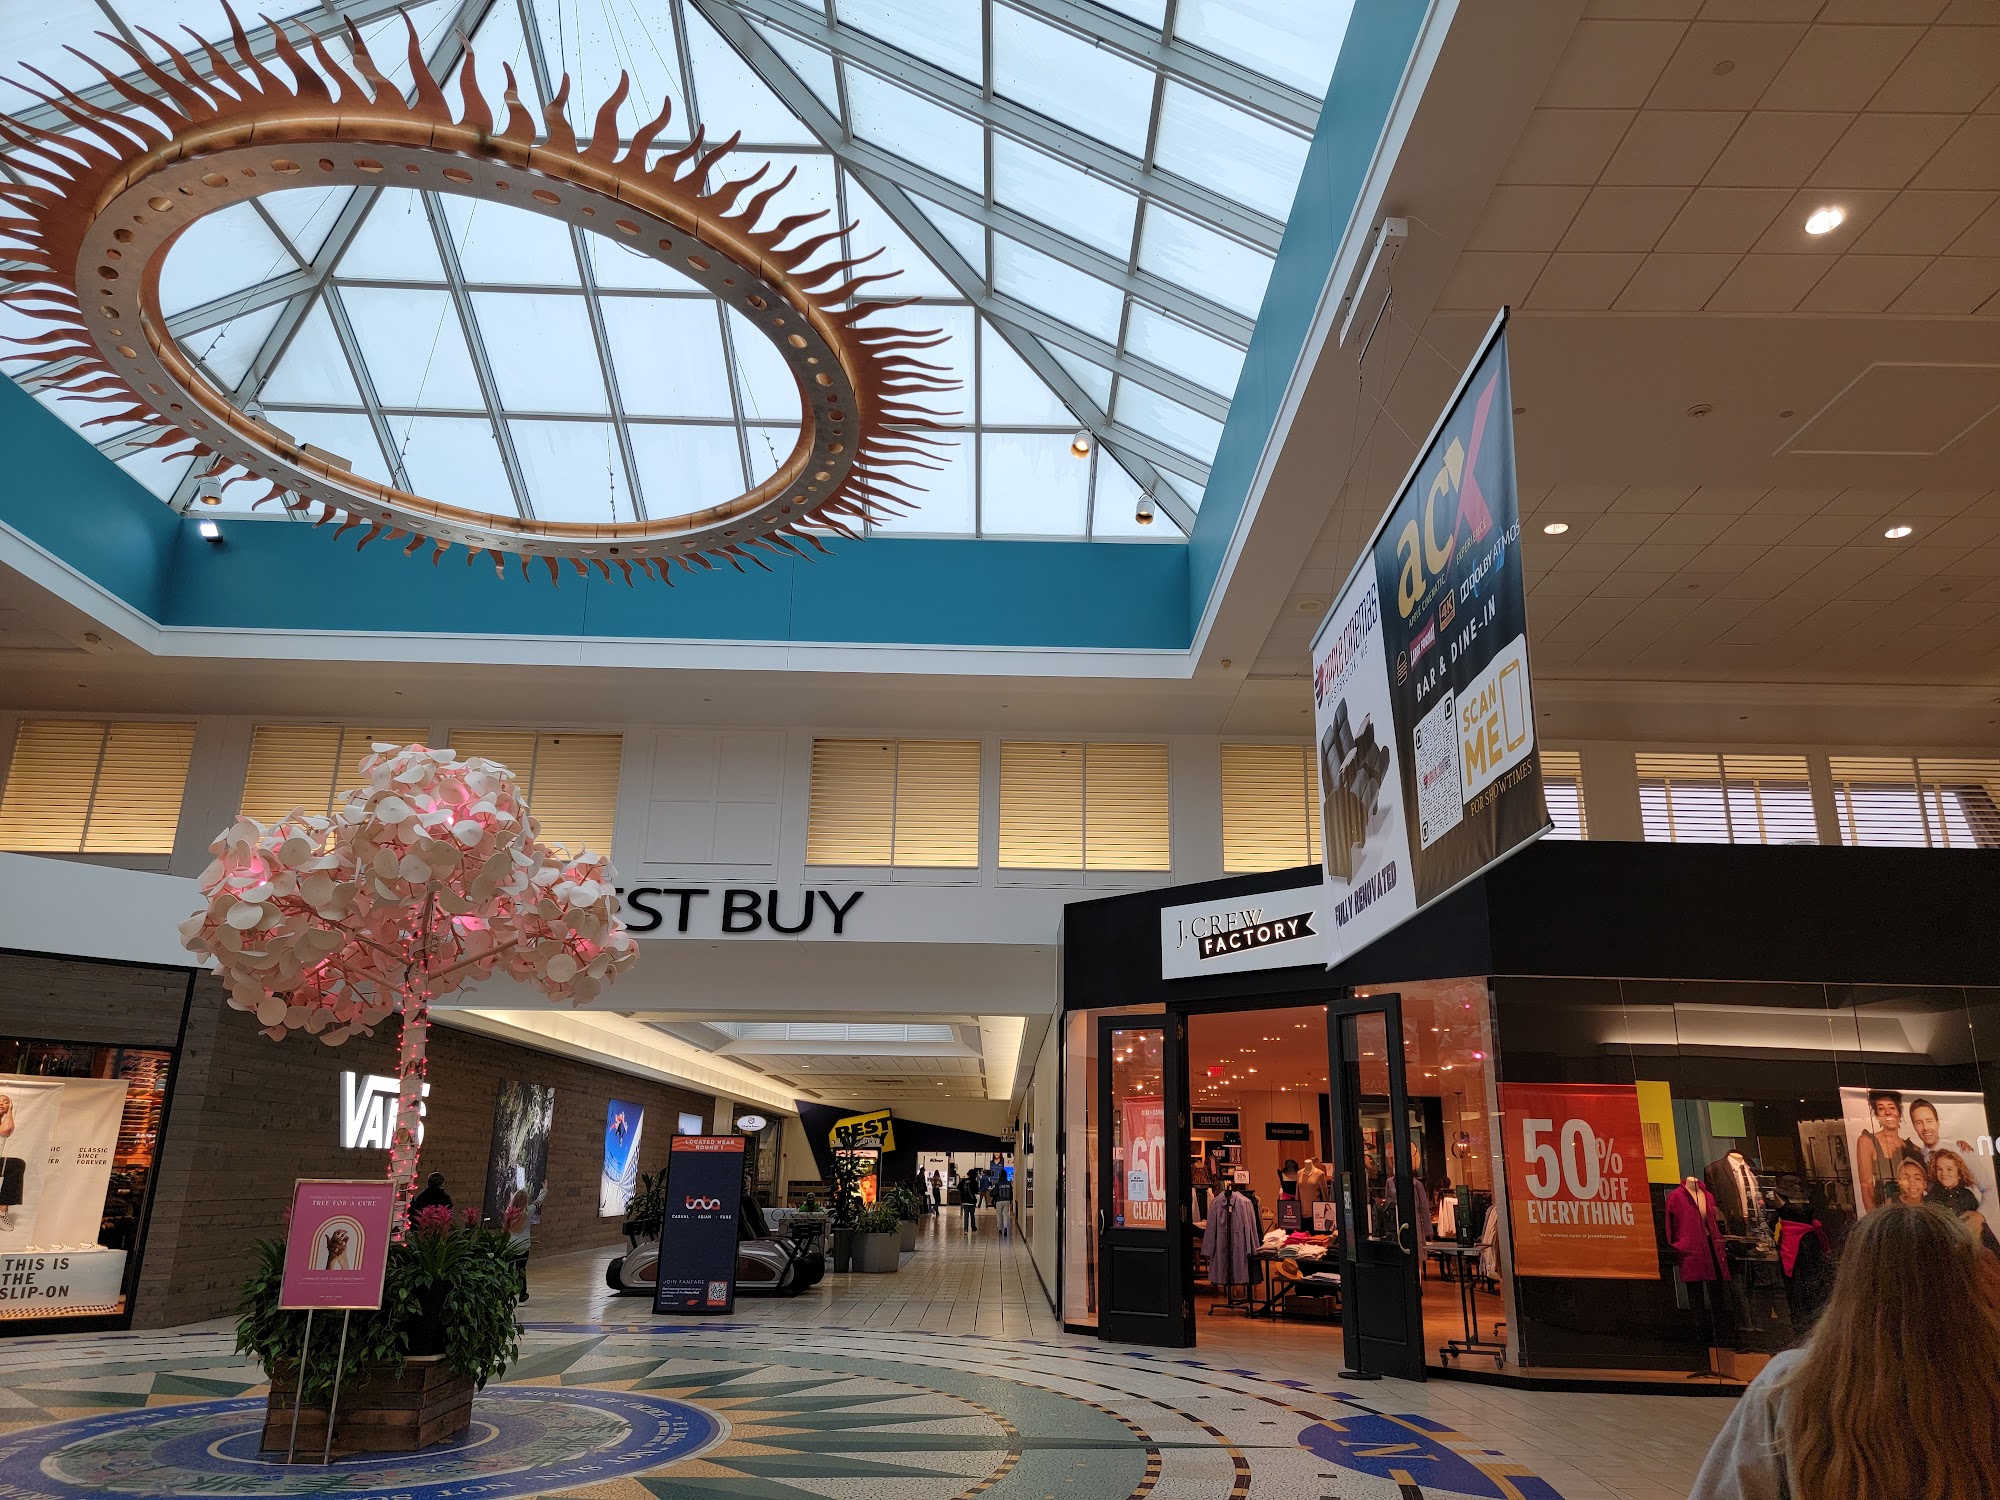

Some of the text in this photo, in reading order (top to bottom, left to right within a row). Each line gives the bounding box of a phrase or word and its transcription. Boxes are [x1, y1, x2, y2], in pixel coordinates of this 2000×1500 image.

[1456, 516, 1488, 566] EXPERIENCE
[1469, 518, 1521, 590] DOLBY ATMOS
[1421, 573, 1446, 613] CINEMATIC
[1441, 596, 1454, 620] 4K
[1416, 667, 1436, 703] BAR
[1439, 657, 1447, 675] &
[1451, 594, 1496, 664] DINE-IN
[1462, 678, 1497, 732] SCAN
[1464, 715, 1503, 787] ME
[1470, 794, 1485, 817] FOR
[1484, 758, 1533, 809] SHOWTIMES
[722, 890, 864, 934] BUY
[1334, 860, 1397, 930] FULLY RENOVATED
[1177, 908, 1263, 949] J.CREW
[1205, 919, 1299, 955] FACTORY
[835, 1117, 891, 1139] BEST
[685, 1195, 721, 1211] boba
[1598, 1177, 1630, 1201] OFF
[1527, 1199, 1635, 1227] EVERYTHING
[2, 1273, 36, 1286] THE
[5, 1258, 70, 1271] THIS IS
[0, 1285, 69, 1300] SLIP-ON
[1338, 1440, 1441, 1462] N
[437, 1481, 517, 1498] NOT
